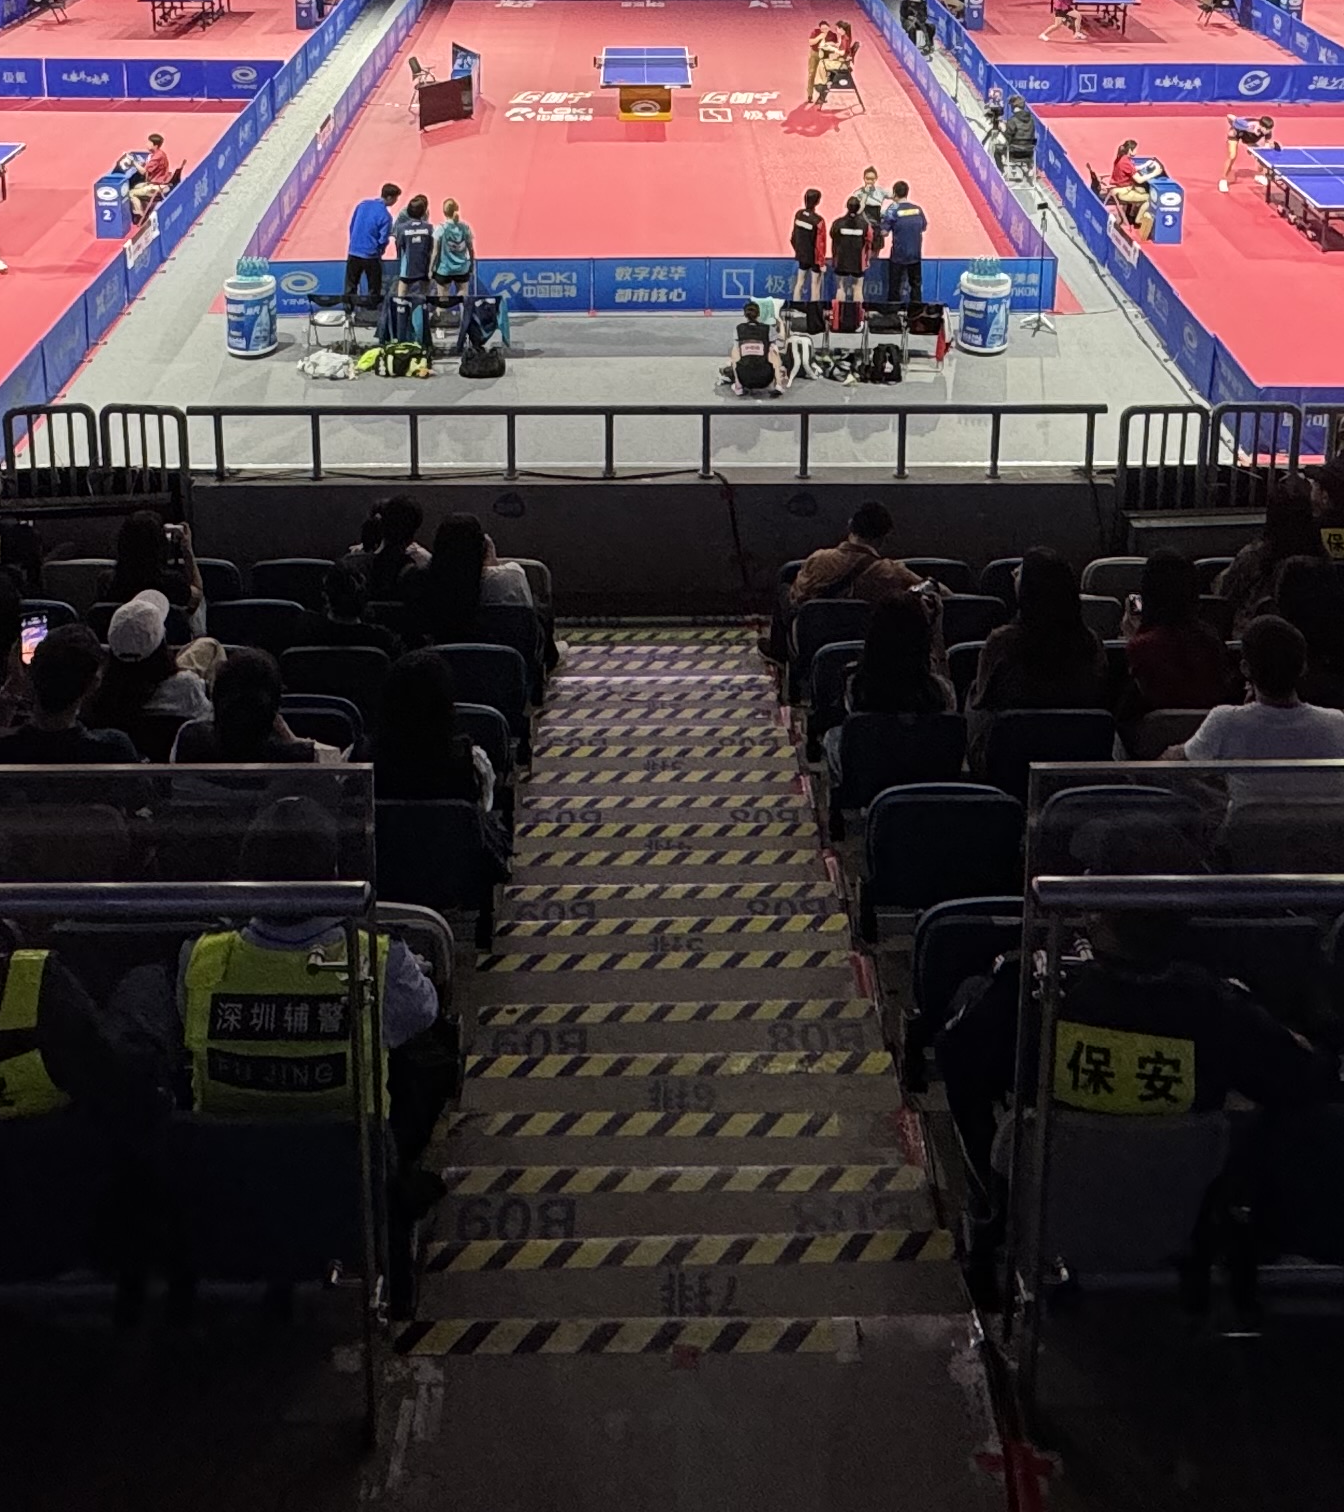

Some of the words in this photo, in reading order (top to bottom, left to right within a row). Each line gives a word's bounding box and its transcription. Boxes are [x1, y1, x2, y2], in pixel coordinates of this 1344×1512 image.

[103, 209, 112, 221] 2
[1164, 214, 1173, 226] 3
[523, 272, 577, 284] LOKI
[615, 266, 686, 281] 数字龙华
[615, 288, 687, 304] 都市核心
[215, 1001, 344, 1034] 深圳辅警
[1066, 1040, 1183, 1103] 保安
[457, 1195, 577, 1240] B09
